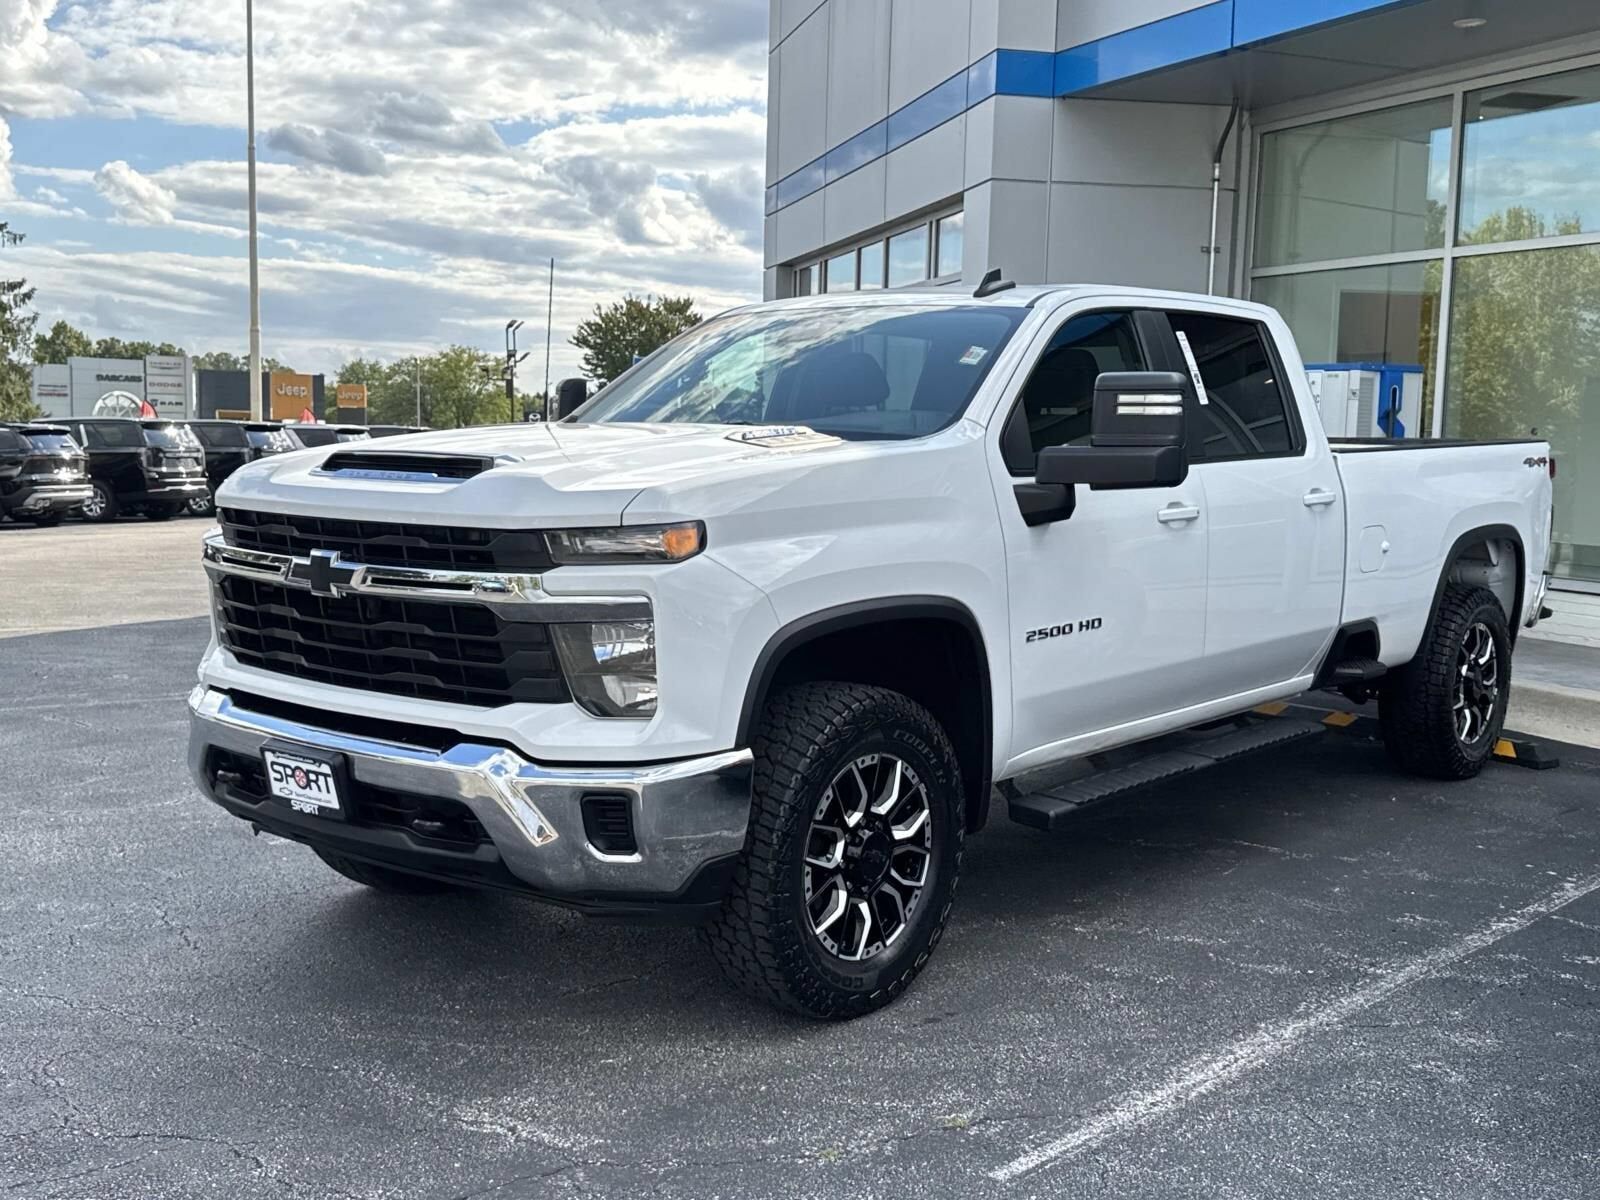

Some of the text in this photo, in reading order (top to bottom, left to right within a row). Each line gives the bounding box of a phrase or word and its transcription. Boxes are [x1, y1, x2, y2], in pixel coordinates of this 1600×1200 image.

[277, 382, 308, 398] Jeep
[338, 389, 364, 401] Jeep
[1025, 617, 1103, 644] 2500 HD
[270, 760, 332, 795] SPORT
[291, 800, 319, 816] SPORT
